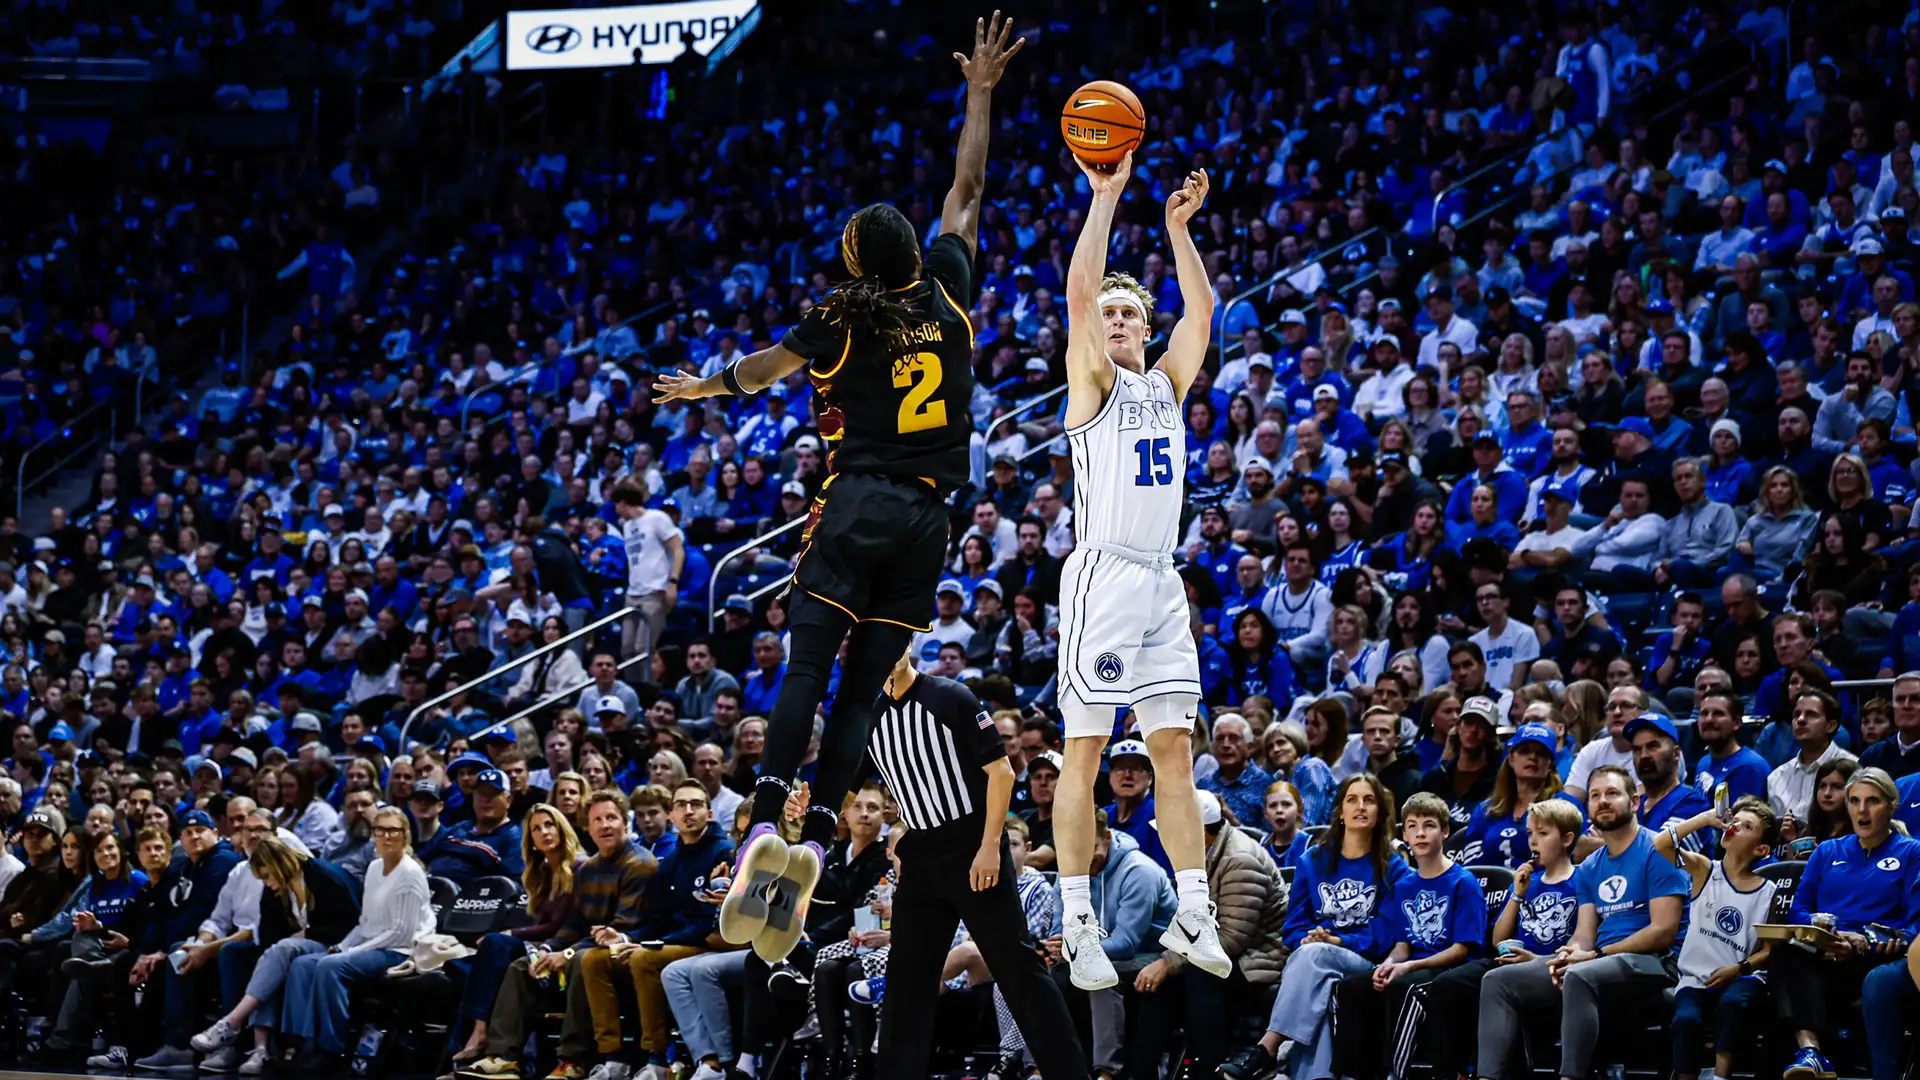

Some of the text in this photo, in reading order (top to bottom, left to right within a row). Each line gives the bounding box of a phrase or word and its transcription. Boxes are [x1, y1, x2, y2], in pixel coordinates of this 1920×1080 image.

[1067, 123, 1108, 144] ELITE
[891, 352, 948, 434] 2
[1118, 400, 1176, 432] BYU
[1134, 437, 1174, 486] 15
[1499, 840, 1513, 868] 1
[1336, 888, 1359, 900] BYU
[1605, 879, 1622, 899] Y
[454, 899, 502, 909] SAPPHIRE
[1534, 896, 1555, 914] BYU
